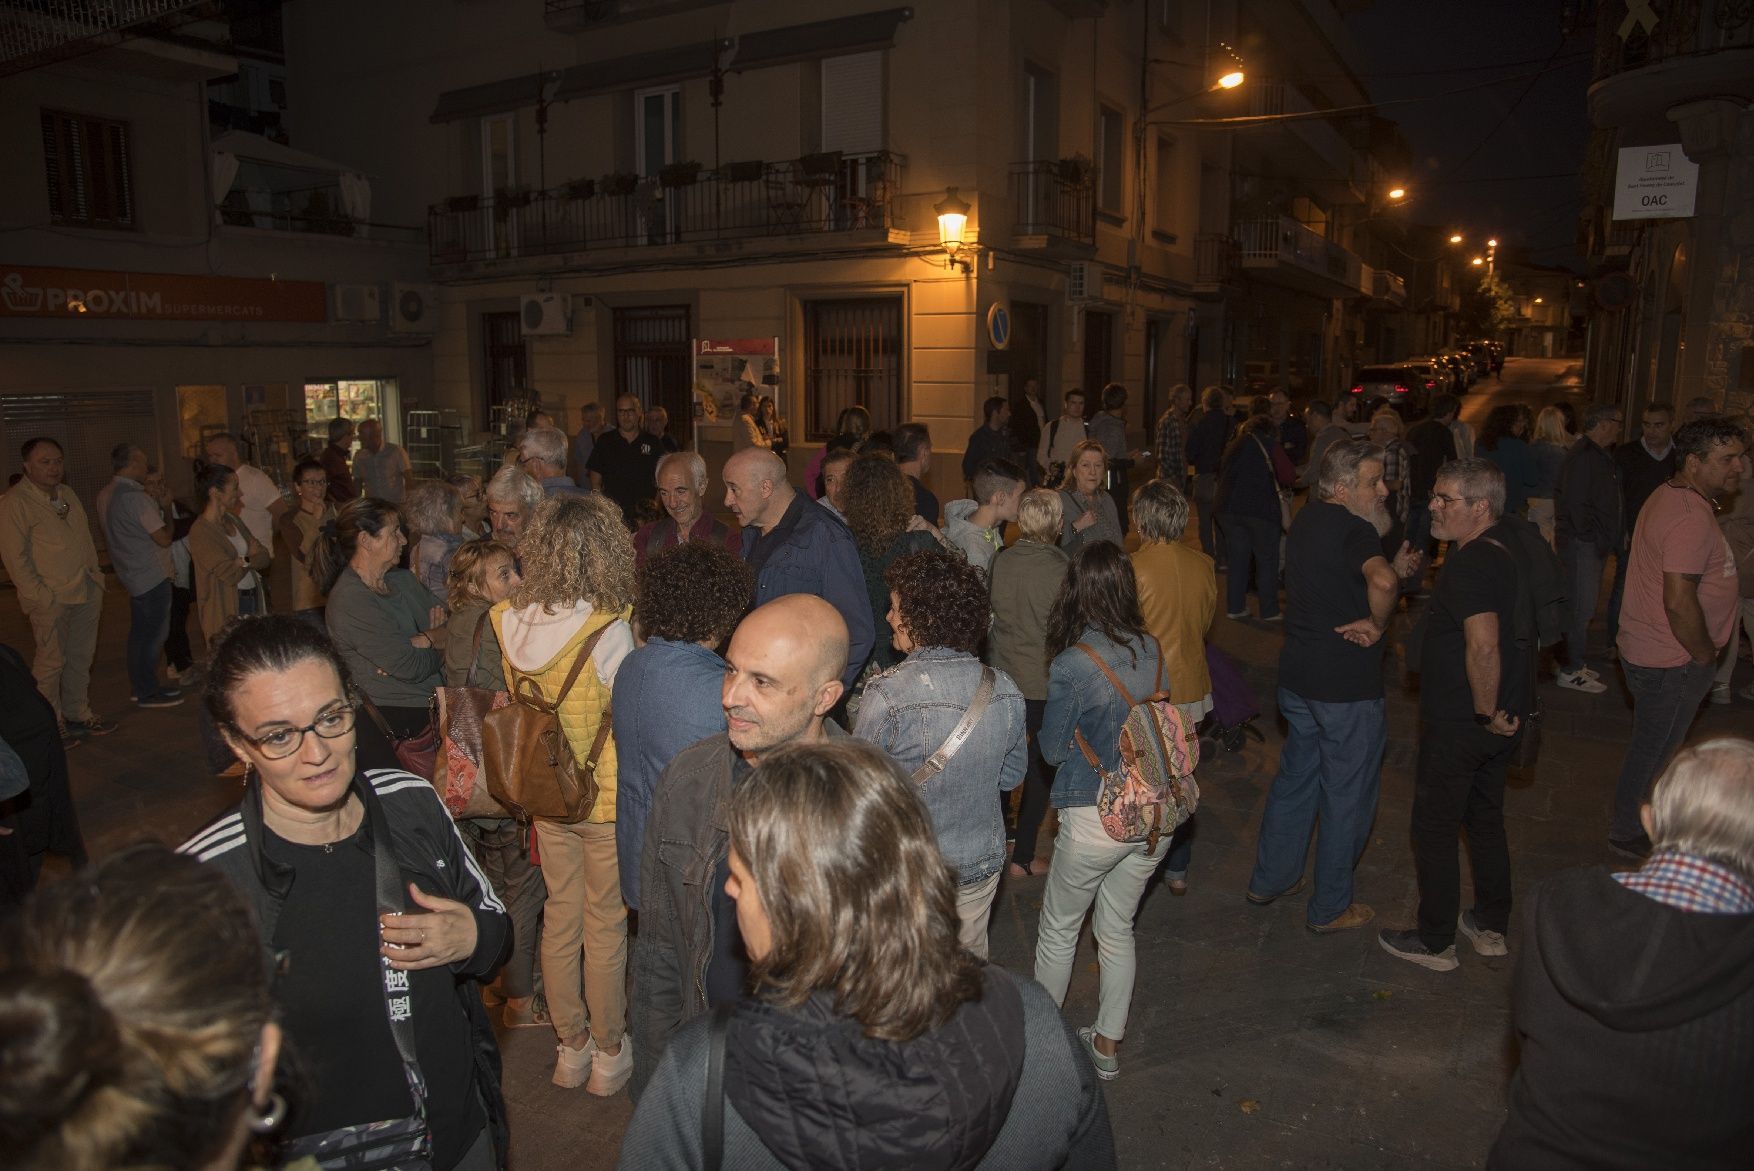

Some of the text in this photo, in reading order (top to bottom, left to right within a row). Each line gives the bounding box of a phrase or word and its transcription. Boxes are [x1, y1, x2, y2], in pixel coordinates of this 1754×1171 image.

[1641, 194, 1668, 206] OAC
[47, 288, 263, 316] PROXIM SUPERMERCATS
